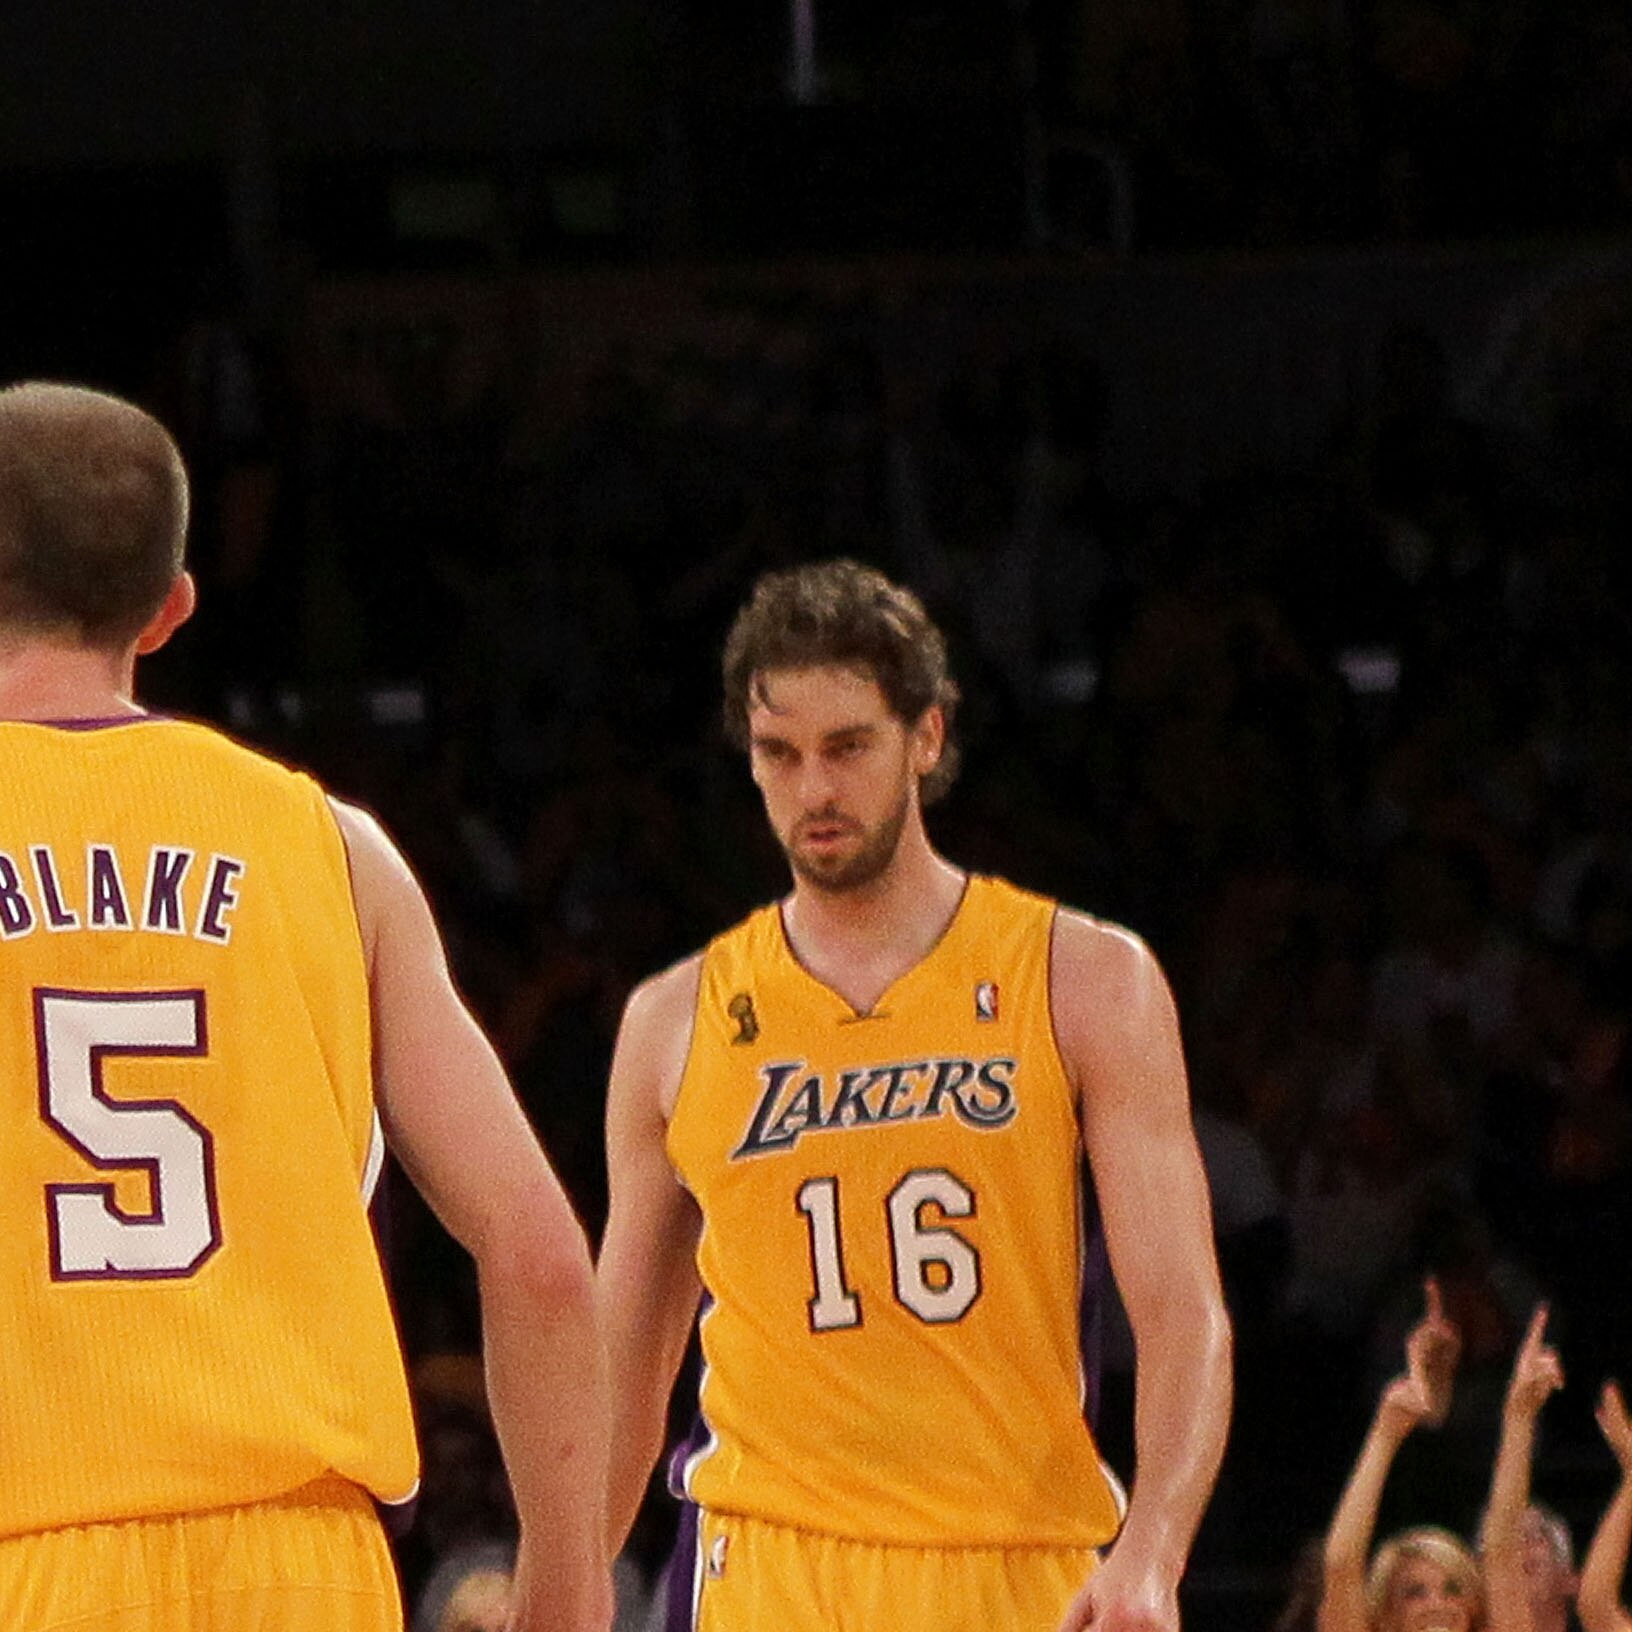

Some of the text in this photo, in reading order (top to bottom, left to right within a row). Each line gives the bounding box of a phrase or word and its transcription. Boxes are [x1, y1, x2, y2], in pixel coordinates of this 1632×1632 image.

[33, 987, 223, 1282] 5
[730, 1056, 1020, 1161] LAKERS
[796, 1166, 983, 1333] 16
